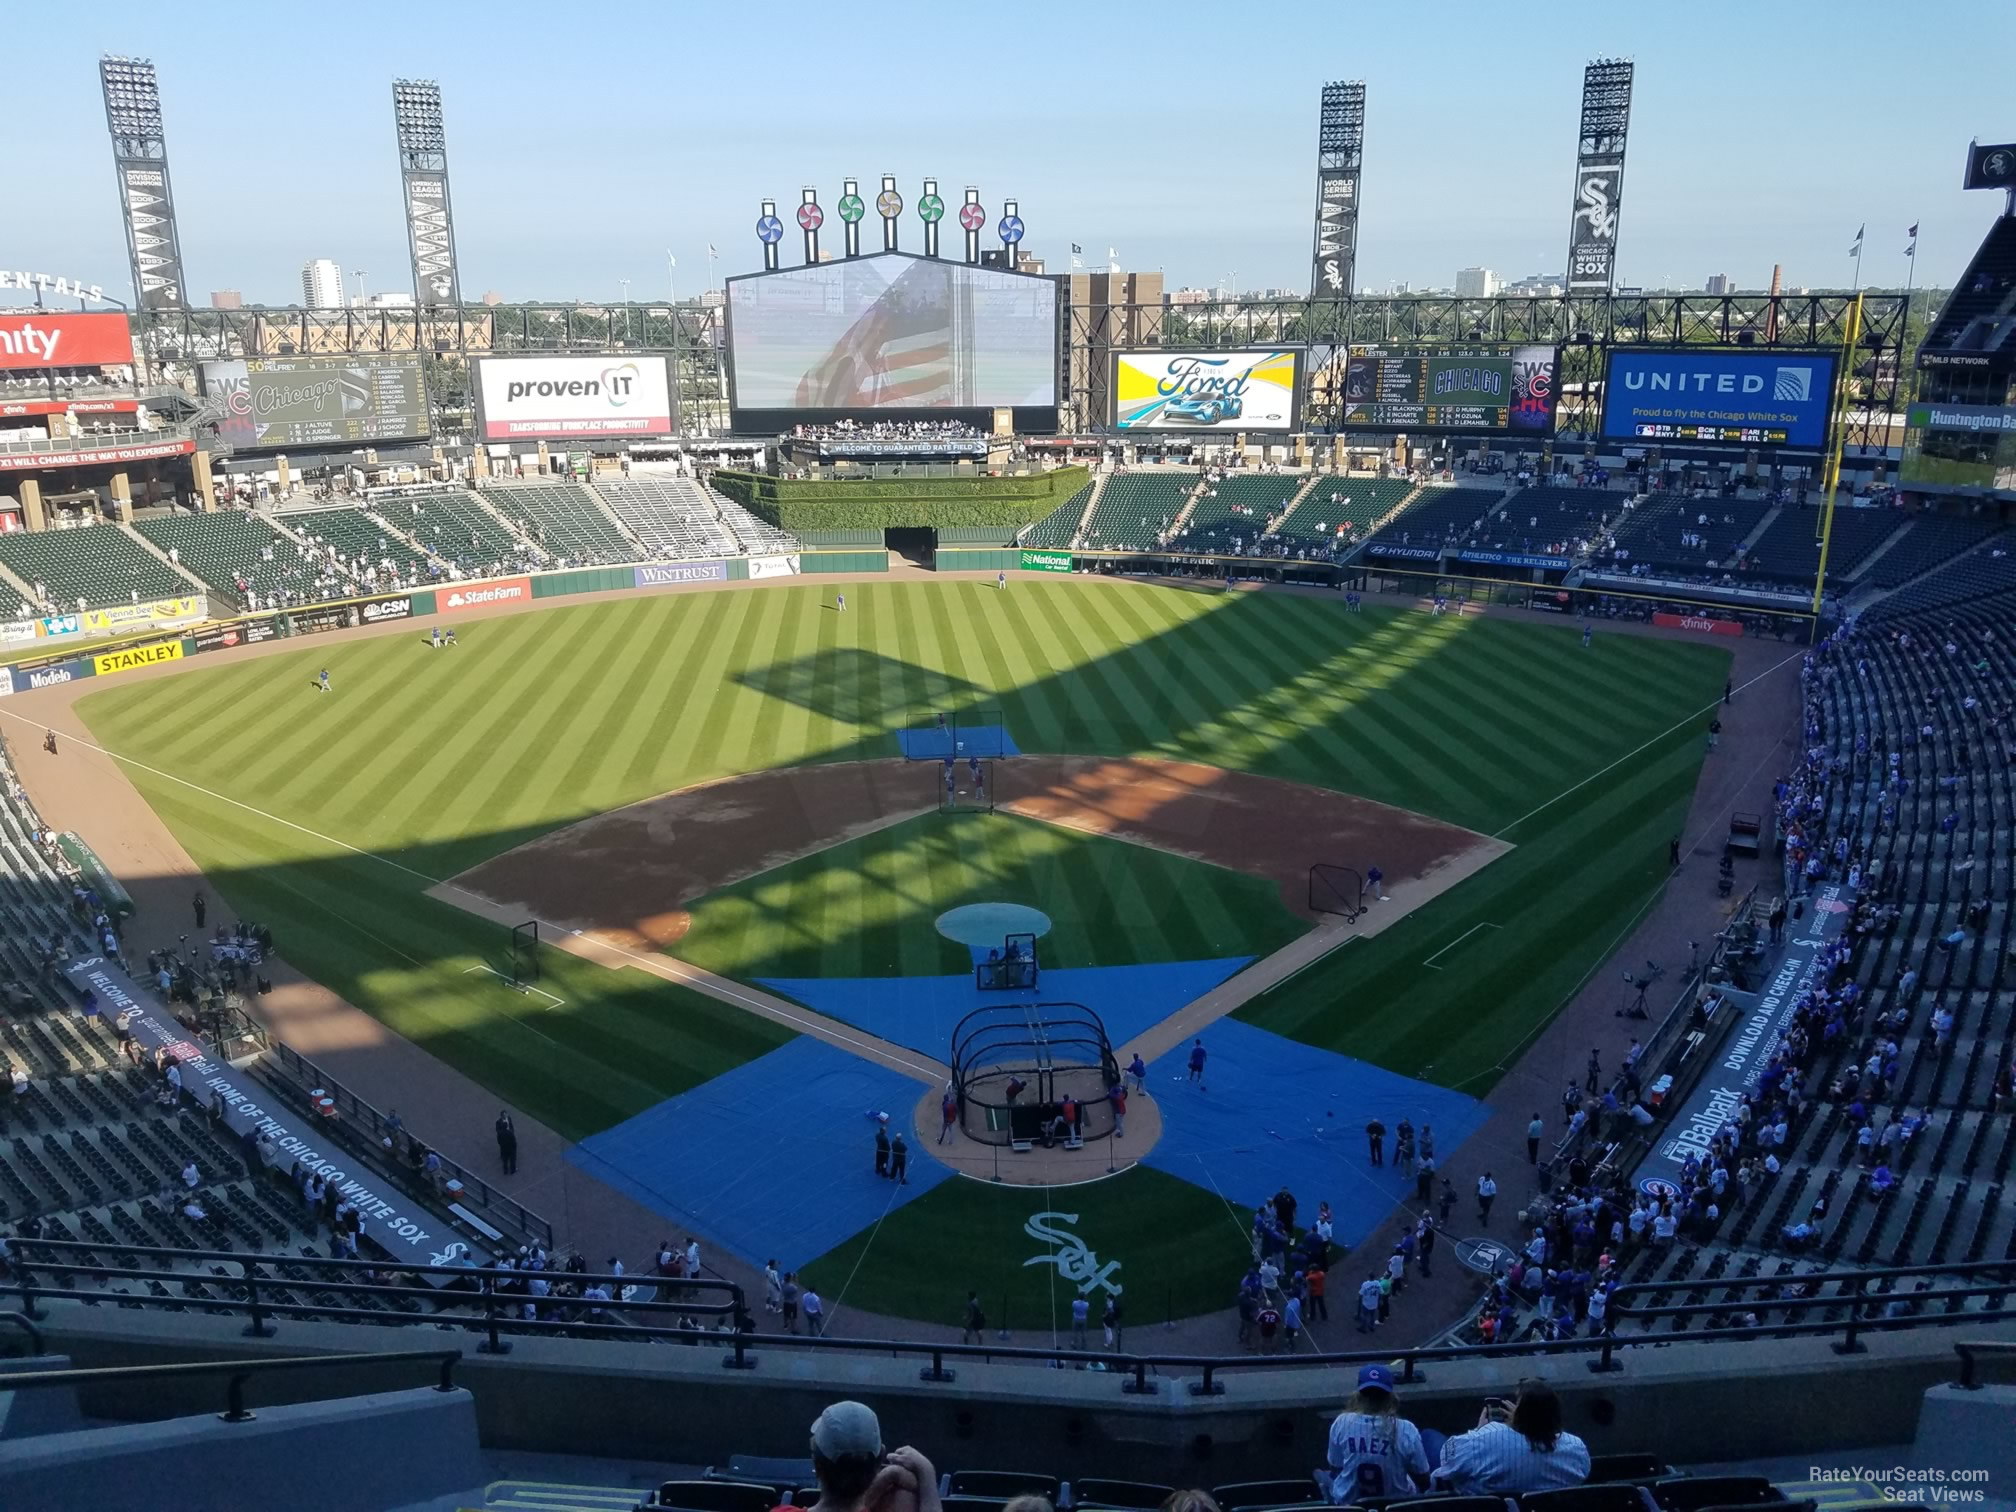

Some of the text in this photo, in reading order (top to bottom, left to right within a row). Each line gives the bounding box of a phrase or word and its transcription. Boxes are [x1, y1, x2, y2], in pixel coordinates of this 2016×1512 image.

[1576, 177, 1616, 238] Sox
[1576, 262, 1606, 274] SOX
[1351, 348, 1364, 356] 34
[247, 361, 264, 372] 50
[1950, 357, 1989, 365] NETWORK
[1157, 357, 1253, 397] Ford
[1434, 367, 1502, 395] CHICAGO
[1625, 372, 1764, 393] UNITED
[255, 378, 338, 415] Chicago
[508, 376, 632, 402] proven IT
[3, 403, 115, 414] xfinity xfinity.com/x1
[1330, 406, 1336, 415] 8
[1632, 407, 1798, 422] Proud to fly the Chicago White Sox
[509, 420, 650, 433] TRANSFORMING WORKPLACE PRODUCTIVITY
[1930, 410, 2001, 430] Huntington
[13, 457, 37, 466] WILL
[39, 455, 78, 465] CHANGE
[80, 453, 97, 462] THE
[98, 451, 118, 460] WAY
[119, 450, 135, 458] YOU
[136, 446, 177, 456] EXPERIENCE
[1033, 554, 1070, 566] National
[1388, 547, 1435, 558] HYUNDAI
[1462, 550, 1502, 560] ATHLETICO
[1524, 558, 1567, 567] RELIEVERS
[104, 610, 133, 618] Vienna
[381, 599, 410, 614] CSN
[2, 625, 25, 633] Bring
[1680, 619, 1714, 631] xfinity
[196, 635, 224, 647] guaranteed
[102, 645, 176, 671] STANLEY
[30, 669, 71, 688] Modelo
[1724, 1015, 1769, 1070] DOWNLOAD
[1758, 994, 1780, 1016] AND
[1742, 1066, 1760, 1087] MAPS
[88, 970, 131, 1007] WELCOME
[123, 1003, 144, 1017] TO
[137, 1017, 180, 1048] guaranteed
[186, 1055, 219, 1076] Field
[206, 1077, 243, 1105] HOME
[238, 1103, 265, 1122] OF
[258, 1116, 284, 1139] THE
[278, 1136, 346, 1182] CHICAGO
[340, 1180, 395, 1220] WHITE
[387, 1210, 431, 1246] SOX
[1679, 1087, 1742, 1146] Ballpark
[1357, 1463, 1384, 1496] 9
